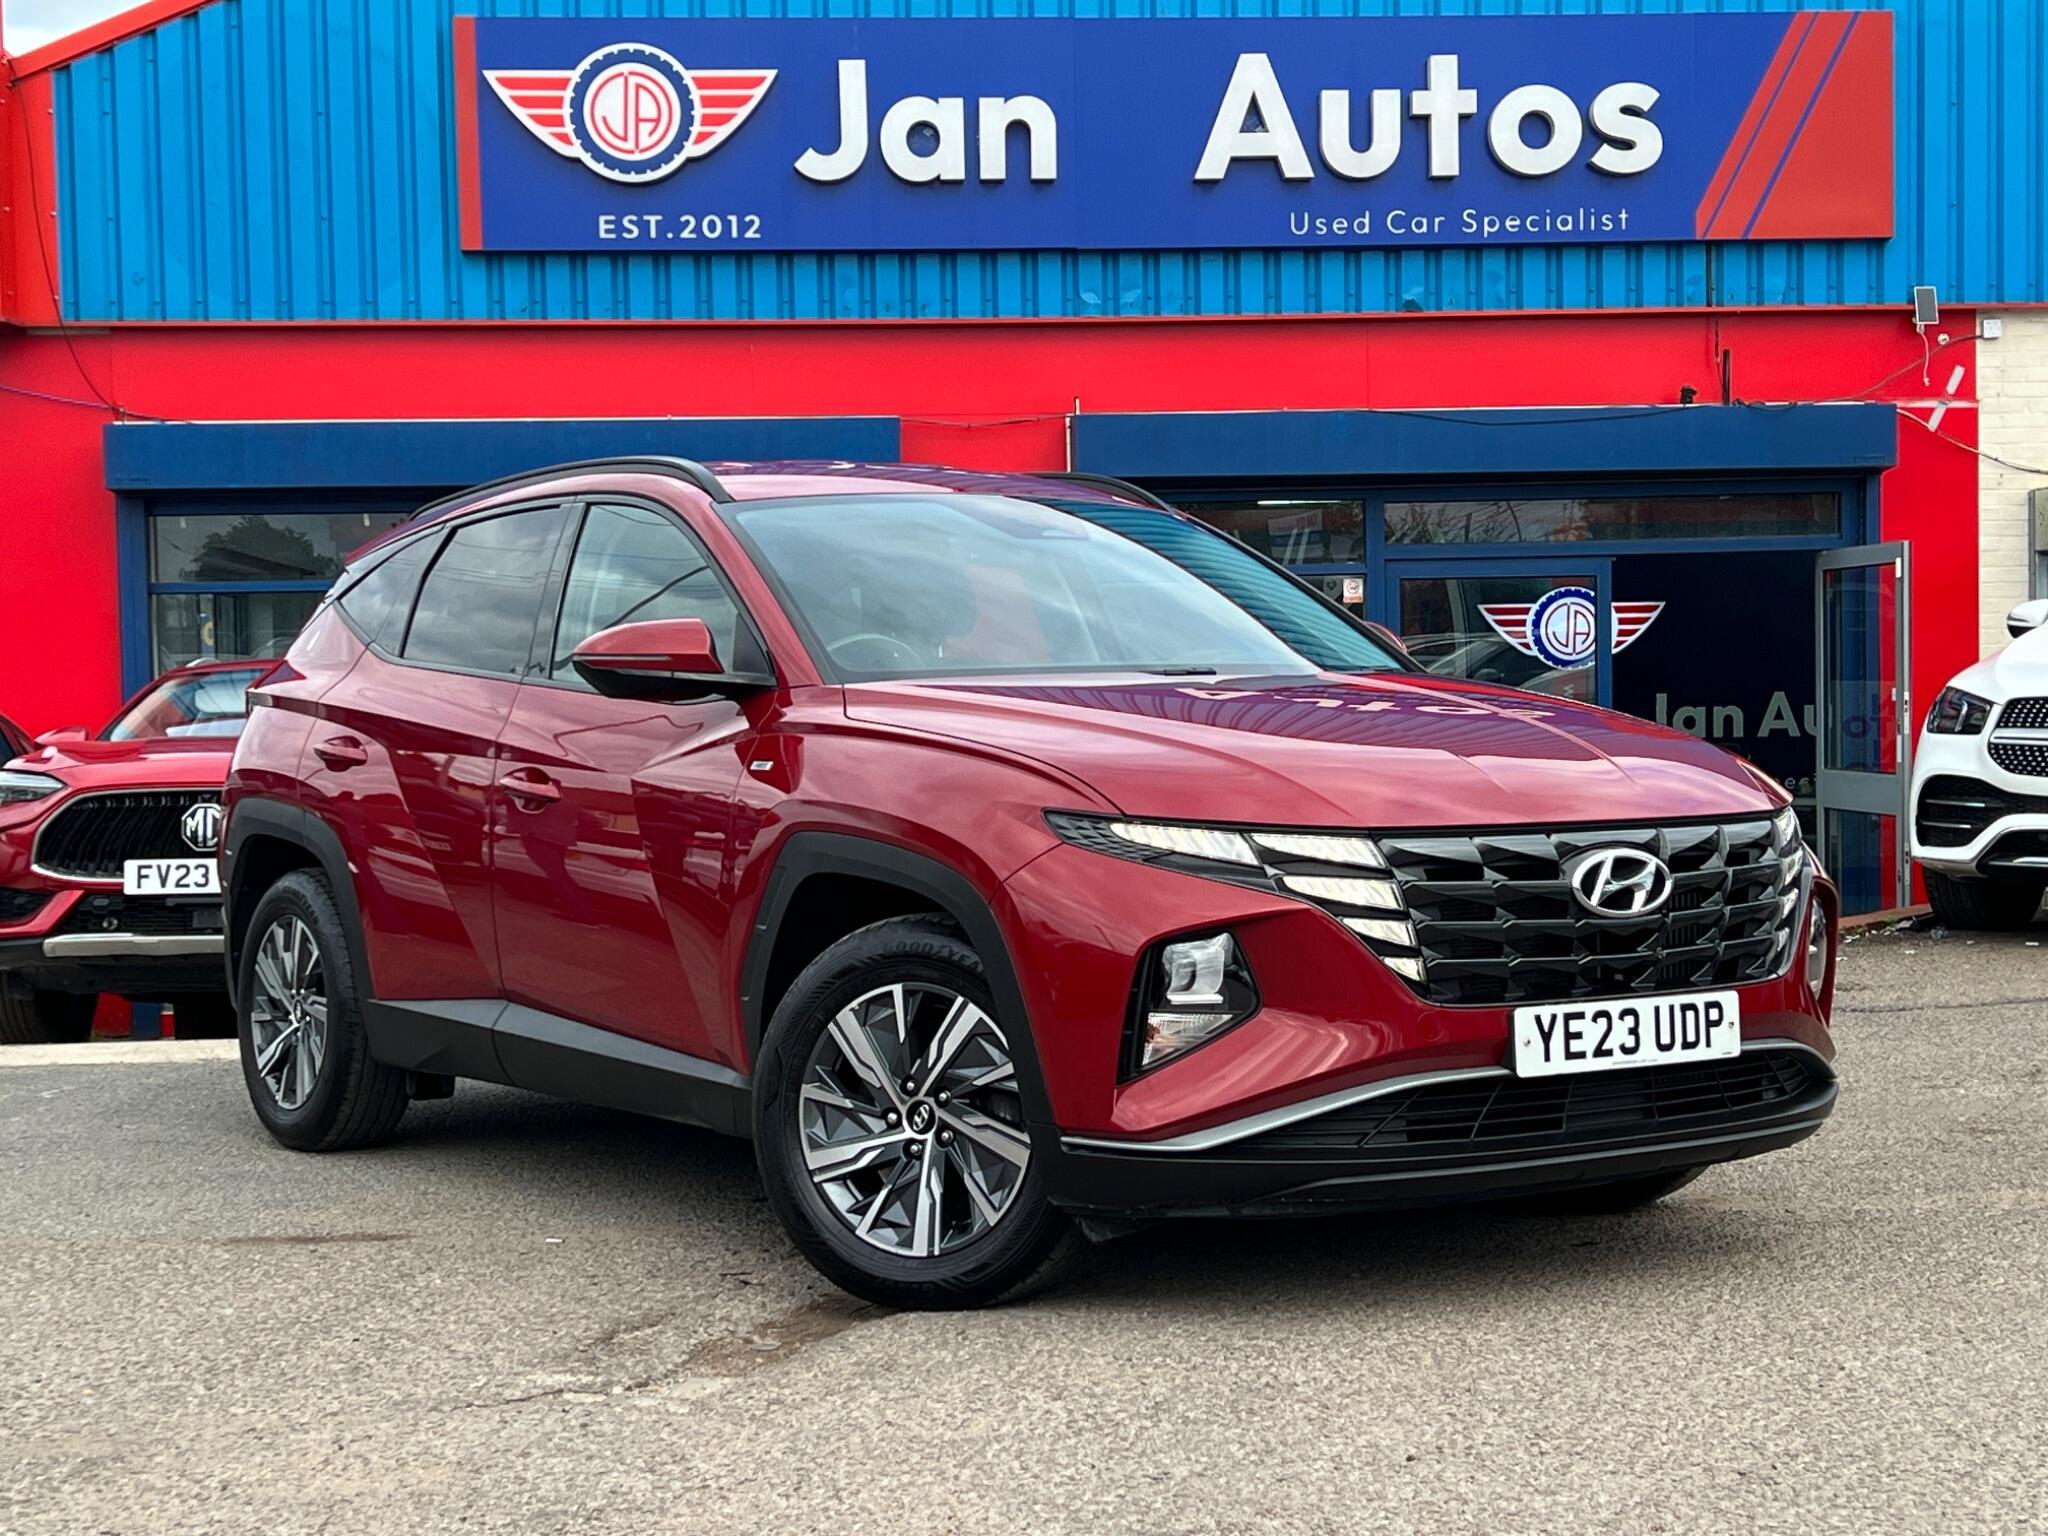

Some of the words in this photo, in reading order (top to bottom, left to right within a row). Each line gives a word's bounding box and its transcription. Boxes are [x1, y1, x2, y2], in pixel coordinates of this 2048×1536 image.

[793, 59, 1058, 183] Jan
[1194, 53, 1664, 183] Autos
[598, 214, 762, 240] EST.2012
[1290, 210, 1371, 236] Used
[1386, 209, 1446, 235] Car
[1461, 208, 1630, 238] Specialist
[1757, 691, 1832, 738] Au
[136, 864, 210, 889] FV23
[1533, 1007, 1641, 1063] YE23
[1654, 1000, 1724, 1053] UDP
